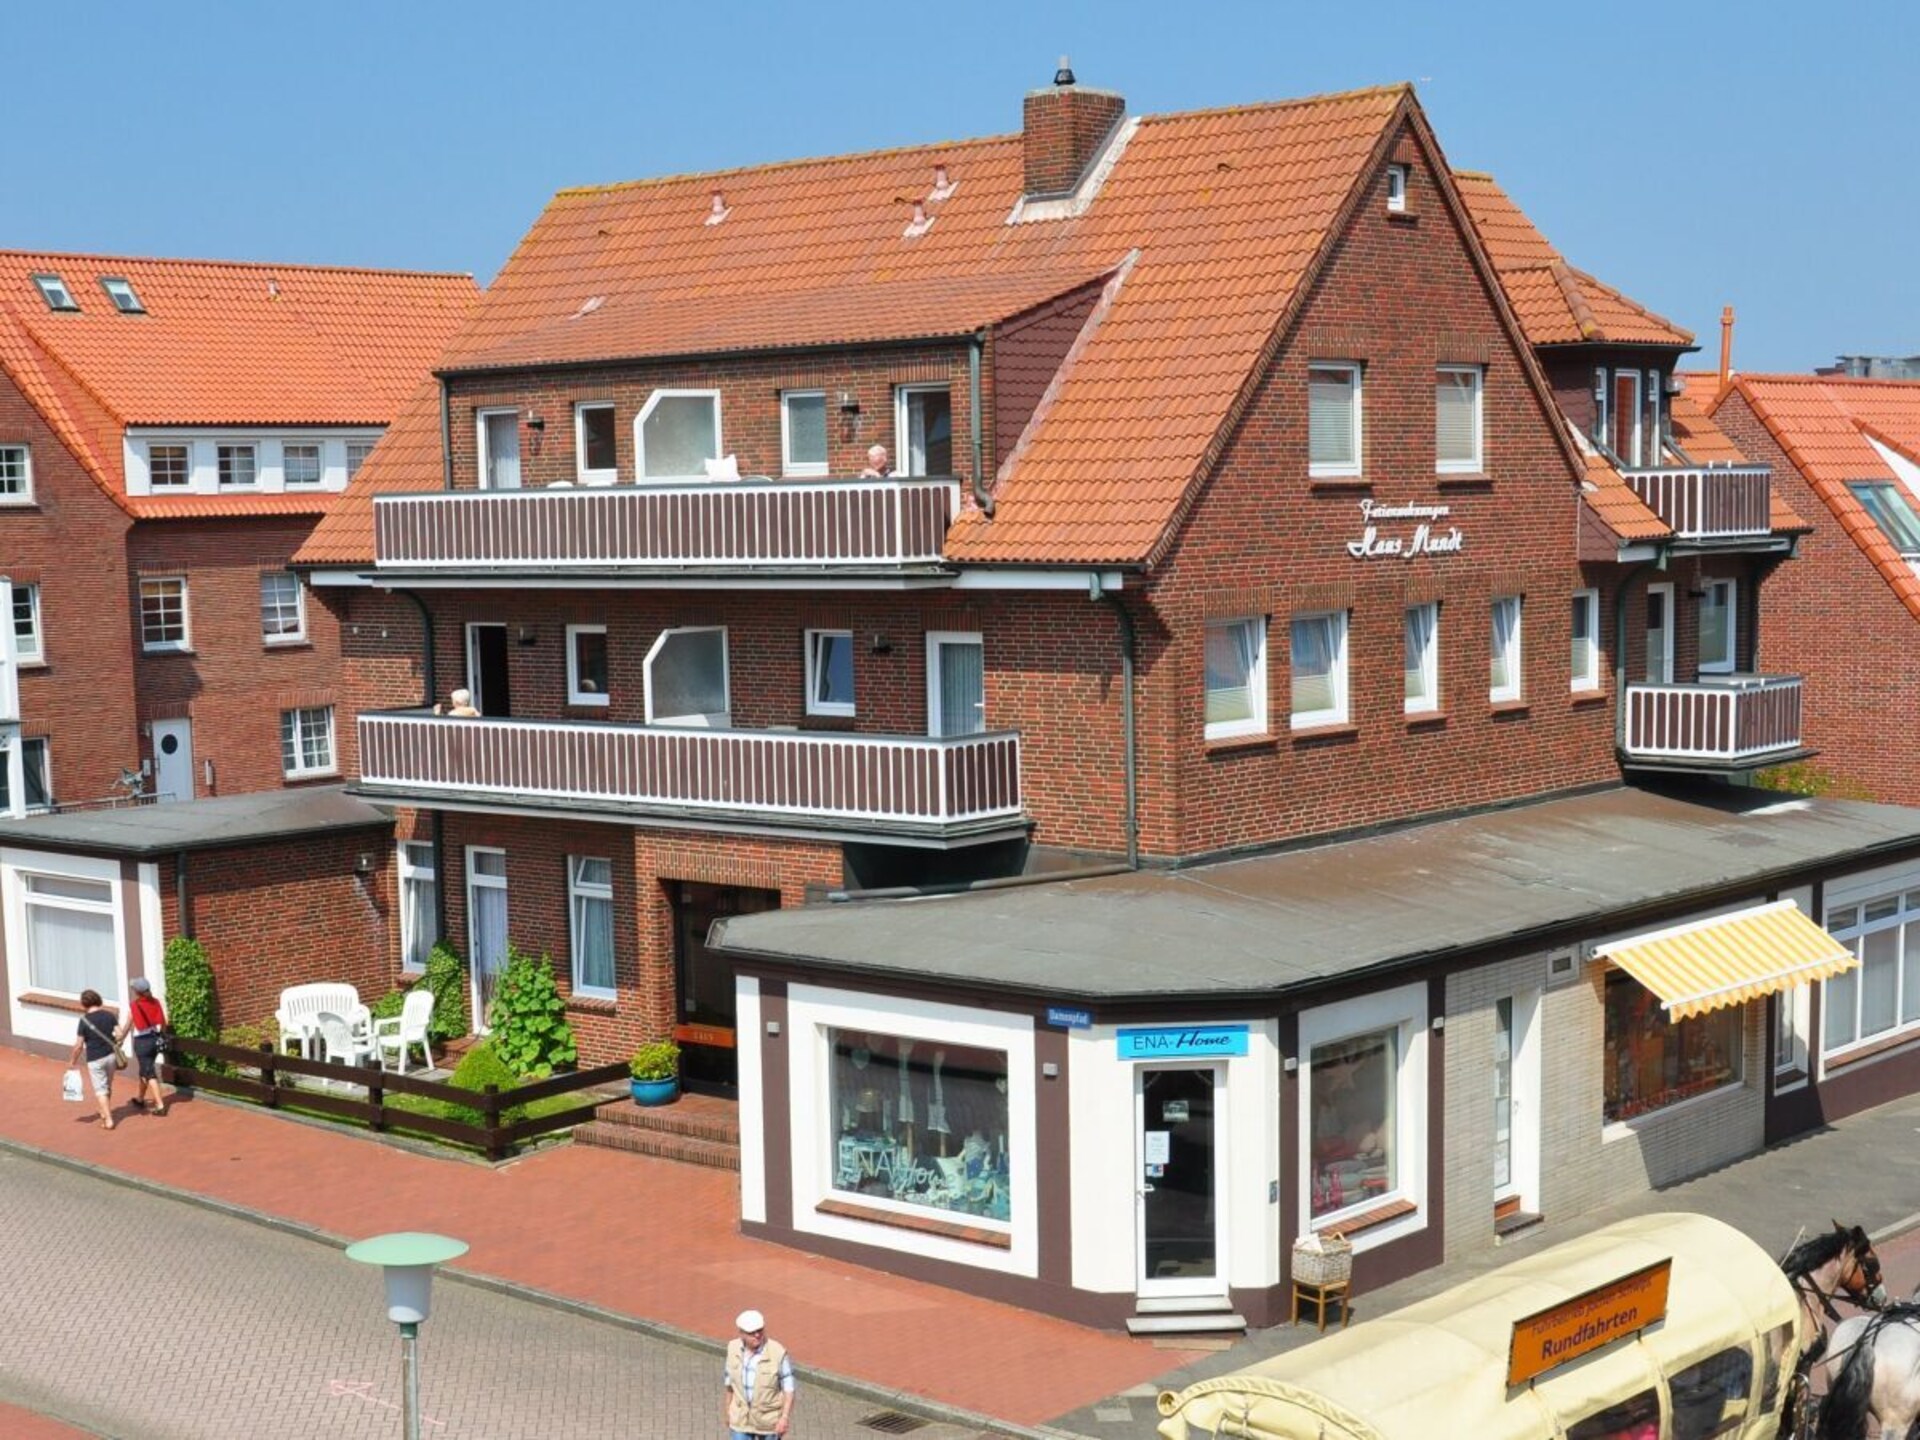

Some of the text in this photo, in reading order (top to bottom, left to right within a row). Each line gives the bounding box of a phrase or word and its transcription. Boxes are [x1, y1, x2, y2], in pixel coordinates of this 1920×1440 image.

[1347, 524, 1462, 558] Haus Mundt
[1541, 1306, 1638, 1360] Rundfahrten
